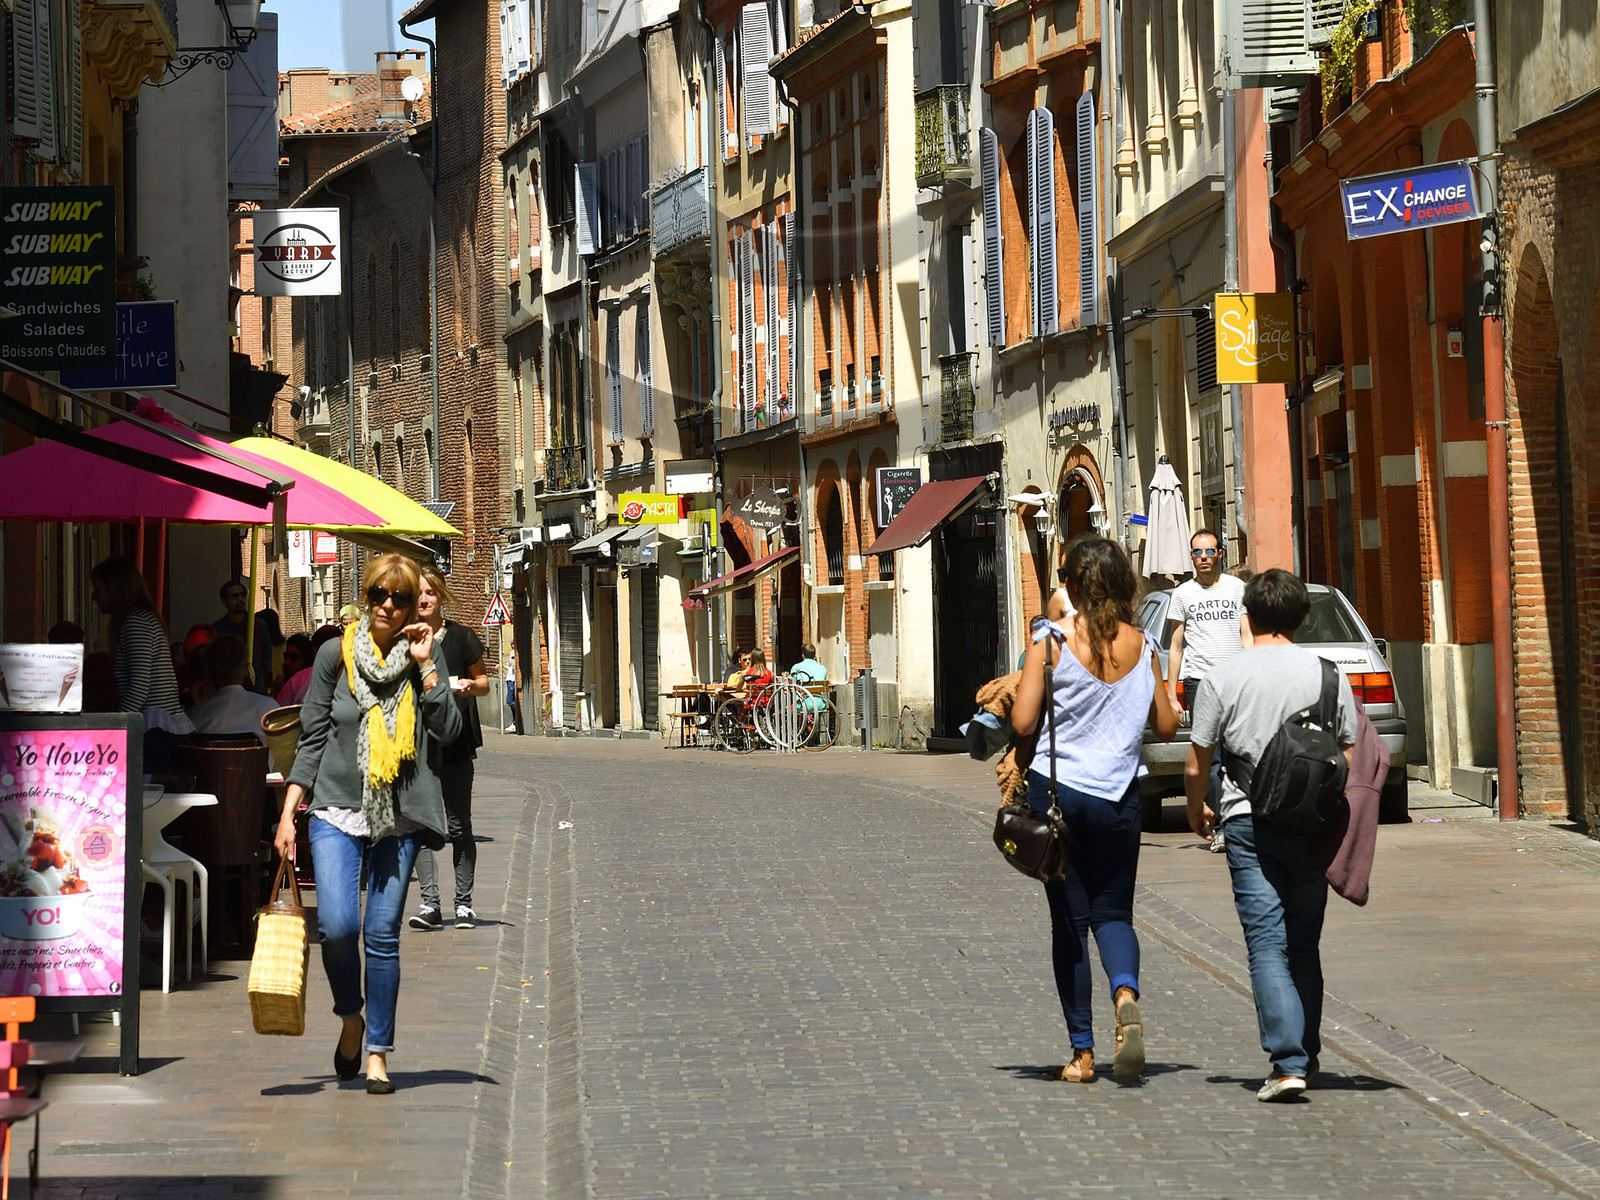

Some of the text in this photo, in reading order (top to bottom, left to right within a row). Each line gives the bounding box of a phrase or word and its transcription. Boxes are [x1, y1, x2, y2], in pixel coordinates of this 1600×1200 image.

[1403, 184, 1467, 207] CHANGE
[4, 200, 104, 223] SUBWAY
[1417, 202, 1471, 219] DEVISES
[4, 232, 104, 255] SUBWAY
[274, 246, 321, 260] YARD
[4, 264, 104, 287] SUBWAY
[7, 302, 101, 316] Sandwiches
[23, 322, 85, 337] Salades
[116, 308, 150, 334] ile
[1220, 310, 1291, 366] Sillage
[2, 343, 106, 358] Boissons Chaudes
[886, 470, 913, 479] Cigarette
[643, 501, 676, 516] PASTA
[740, 498, 781, 518] Le Sherpa
[1188, 599, 1238, 613] CARTON
[1196, 610, 1235, 622] ROUGE
[15, 744, 38, 767] Yo
[85, 768, 114, 777] Toulouse
[43, 787, 77, 803] Frozen
[79, 797, 111, 819] Yogurt
[22, 907, 60, 926] YO!
[53, 961, 62, 969] et
